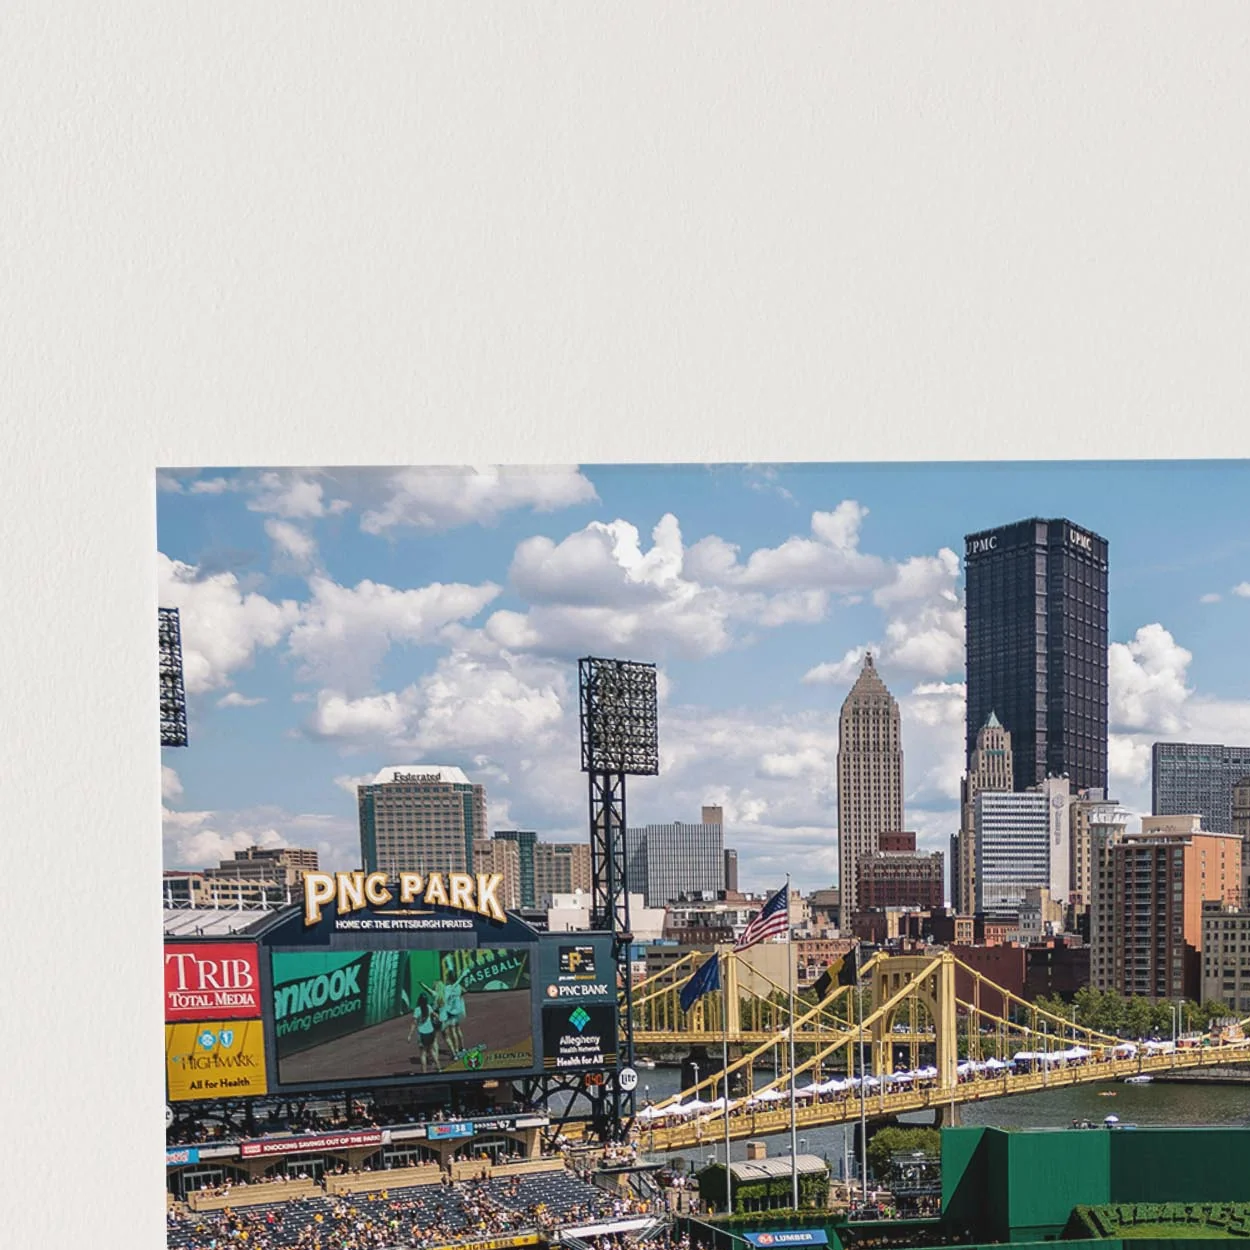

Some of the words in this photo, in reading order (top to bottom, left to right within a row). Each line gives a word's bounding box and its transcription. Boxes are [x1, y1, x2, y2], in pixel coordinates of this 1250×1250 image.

[1069, 529, 1092, 551] UPMC
[392, 771, 441, 783] Federated
[301, 871, 393, 927] PNC
[400, 871, 508, 924] PARK
[335, 919, 360, 930] HOME
[361, 919, 374, 929] OF
[375, 919, 390, 929] THE
[391, 919, 441, 929] PITTSBURGH
[441, 919, 474, 928] PIRATES
[165, 953, 253, 991] TRIB
[559, 985, 582, 996] PNC
[582, 984, 608, 995] BANK
[168, 991, 213, 1008] TOTAL
[214, 991, 256, 1006] MEDIA
[312, 998, 362, 1024] emotion
[560, 1035, 600, 1046] Allegheny
[181, 1053, 256, 1071] HIGHMARK
[556, 1055, 581, 1067] Health
[581, 1055, 592, 1065] for
[592, 1054, 604, 1065] All
[190, 1080, 203, 1090] All
[204, 1079, 218, 1089] for
[219, 1076, 250, 1088] Health
[621, 1072, 636, 1086] Lite
[263, 1142, 298, 1152] KNOCKING
[298, 1140, 326, 1150] SAVINGS
[326, 1138, 339, 1146] OUT
[774, 1233, 813, 1242] LUMBER
